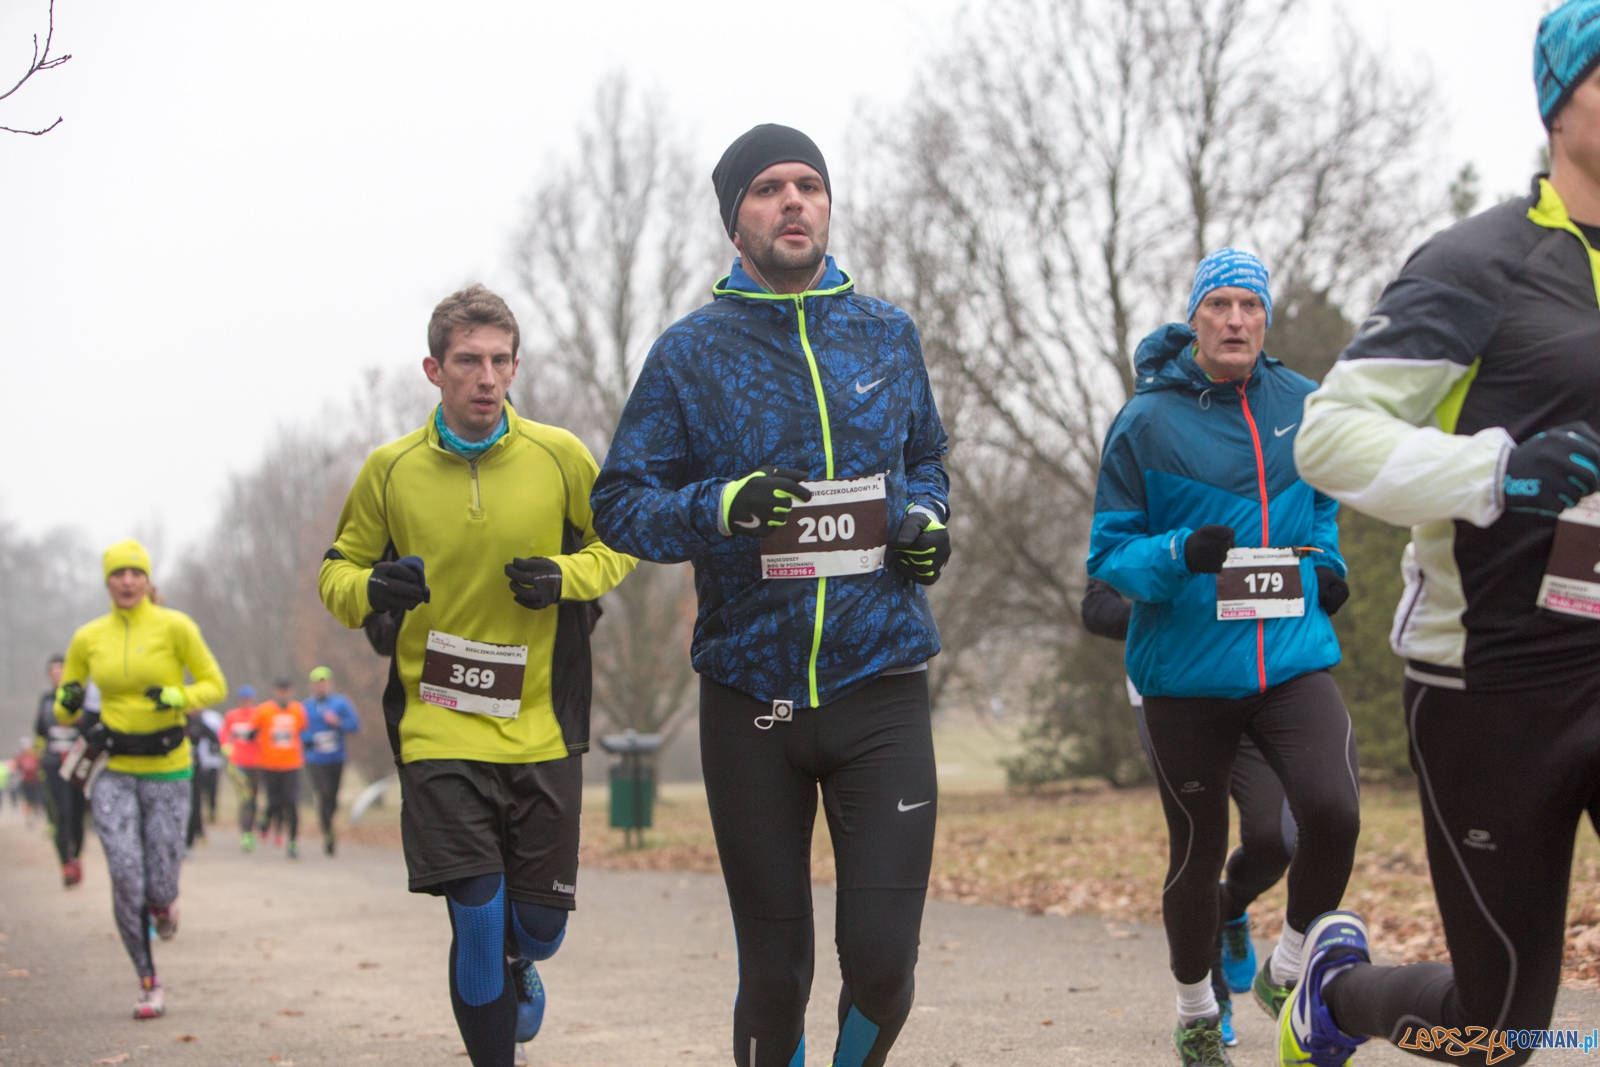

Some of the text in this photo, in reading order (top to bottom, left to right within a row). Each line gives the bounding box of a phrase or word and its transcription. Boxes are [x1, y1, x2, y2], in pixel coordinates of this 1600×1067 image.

[797, 513, 856, 544] 200
[1244, 572, 1284, 593] 179
[449, 663, 496, 690] 369
